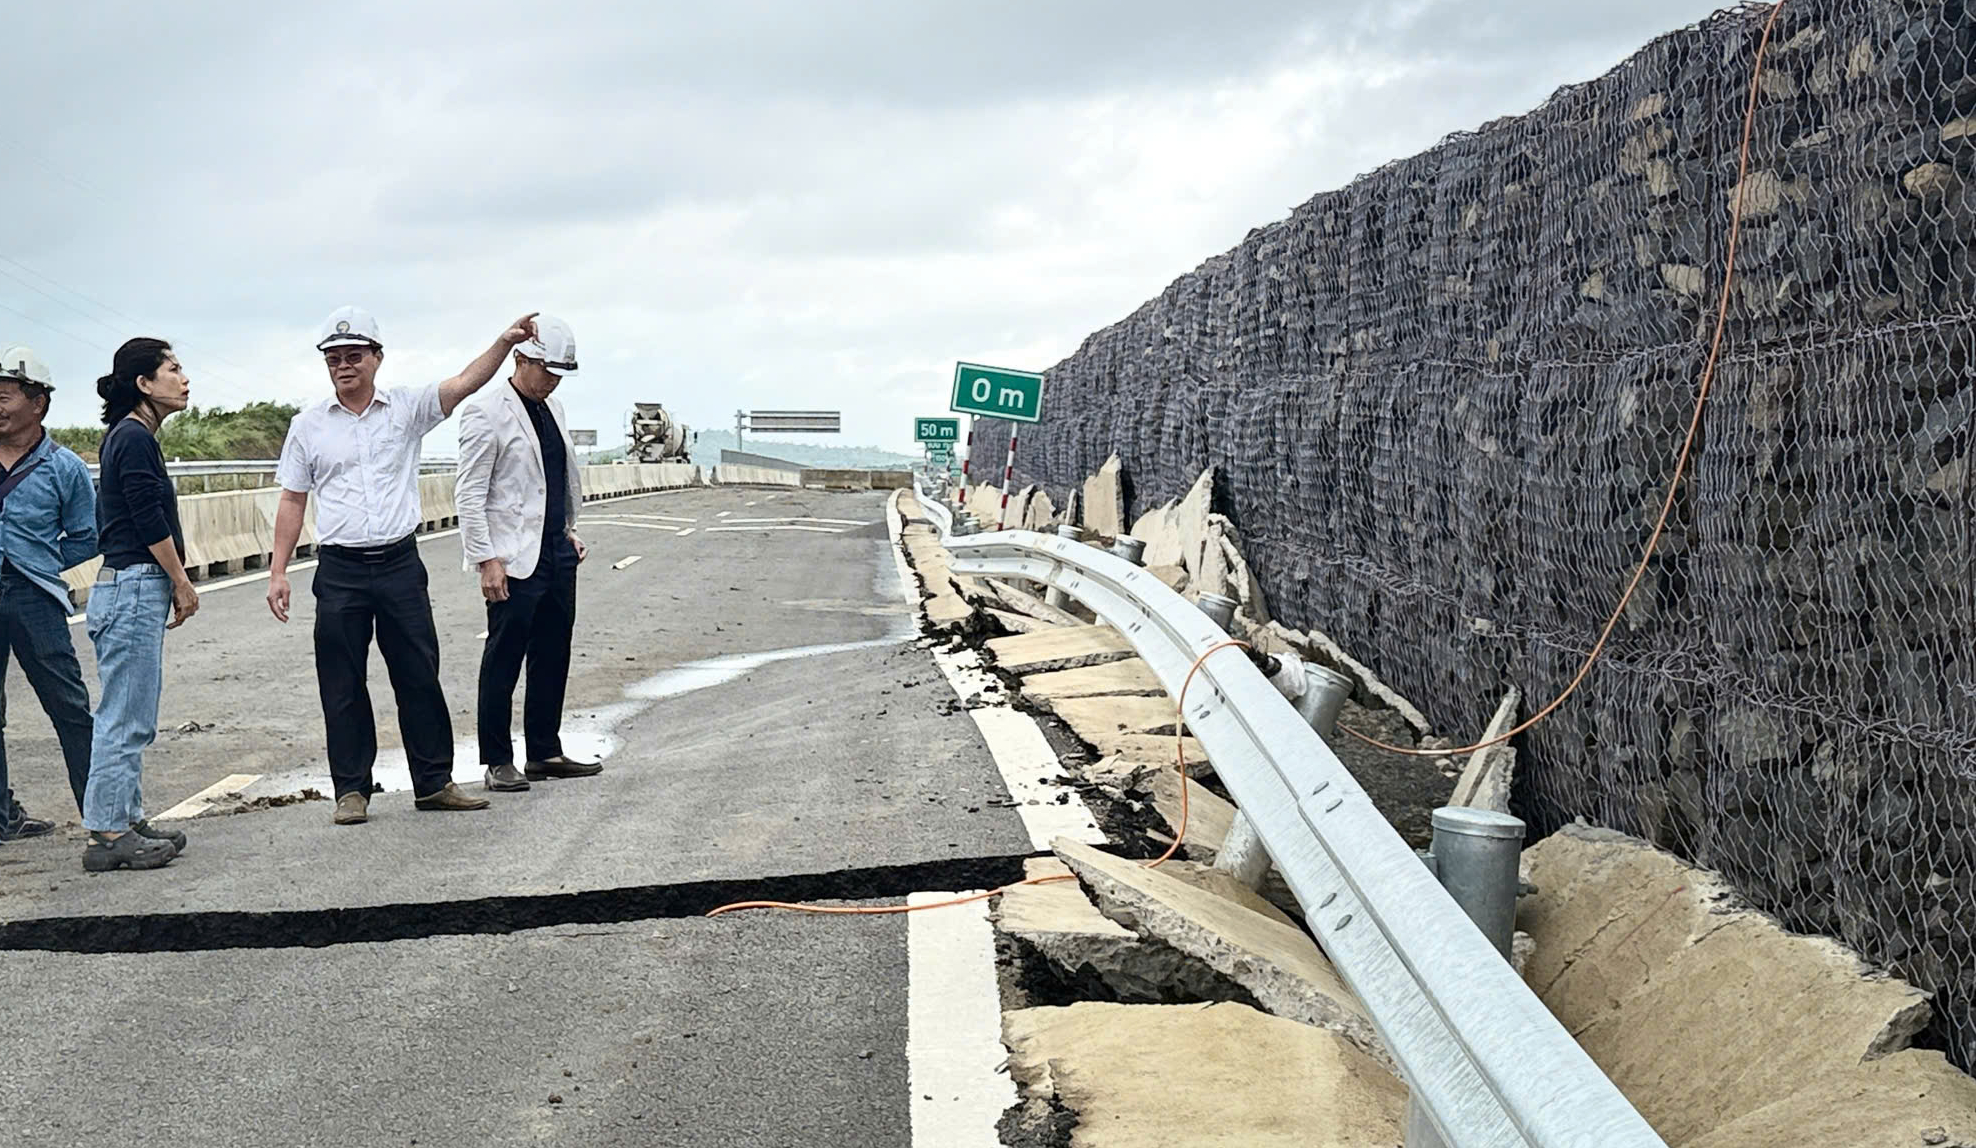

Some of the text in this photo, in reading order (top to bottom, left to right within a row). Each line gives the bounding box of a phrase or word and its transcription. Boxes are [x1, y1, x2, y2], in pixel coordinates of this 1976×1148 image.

[971, 377, 1025, 409] 0 m
[920, 423, 954, 437] 50 m
